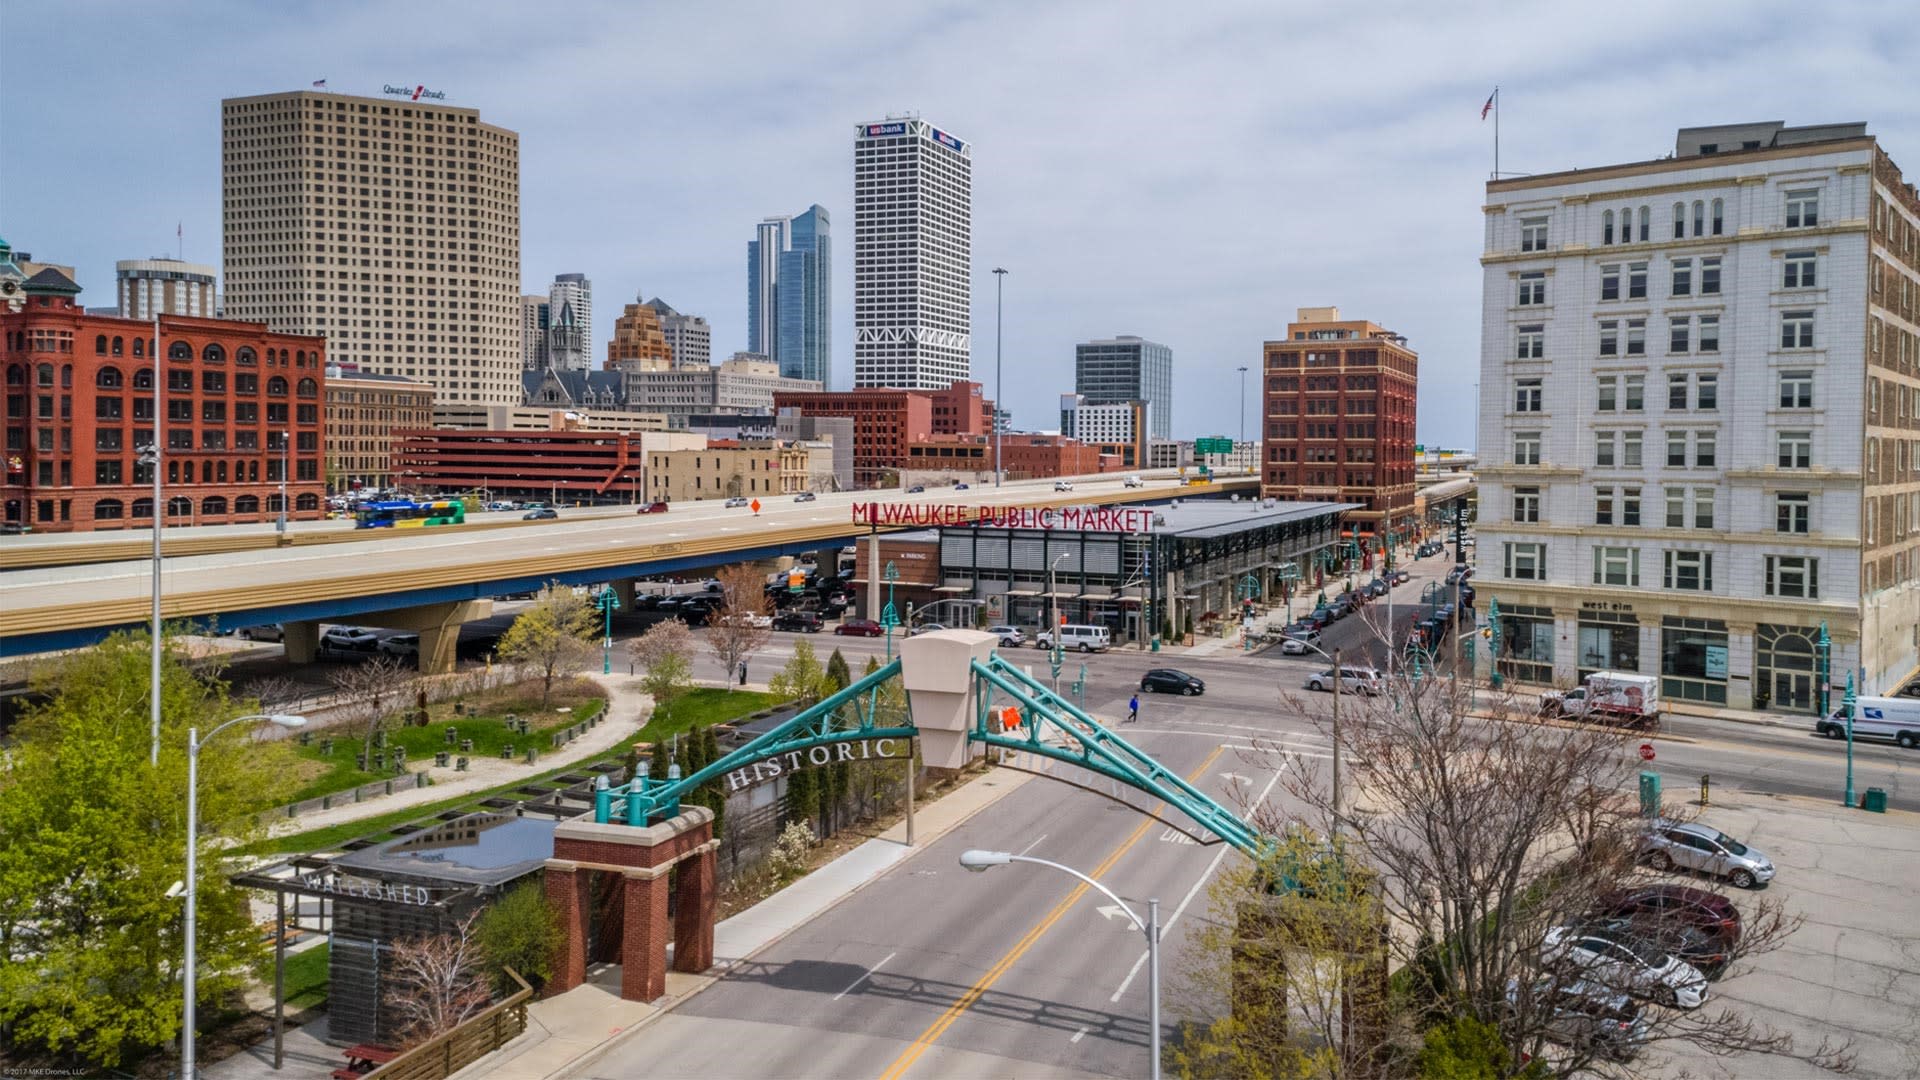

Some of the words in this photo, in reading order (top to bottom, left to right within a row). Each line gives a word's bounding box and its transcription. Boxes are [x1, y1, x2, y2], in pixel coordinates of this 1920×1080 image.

[383, 84, 413, 95] Quarles
[852, 502, 967, 526] MILWAUKEE
[979, 506, 1054, 529] PUBLIC
[1063, 508, 1153, 532] MARKET
[1612, 602, 1632, 610] elm
[727, 738, 896, 791] HISTORIC
[302, 873, 429, 906] WATERSHED
